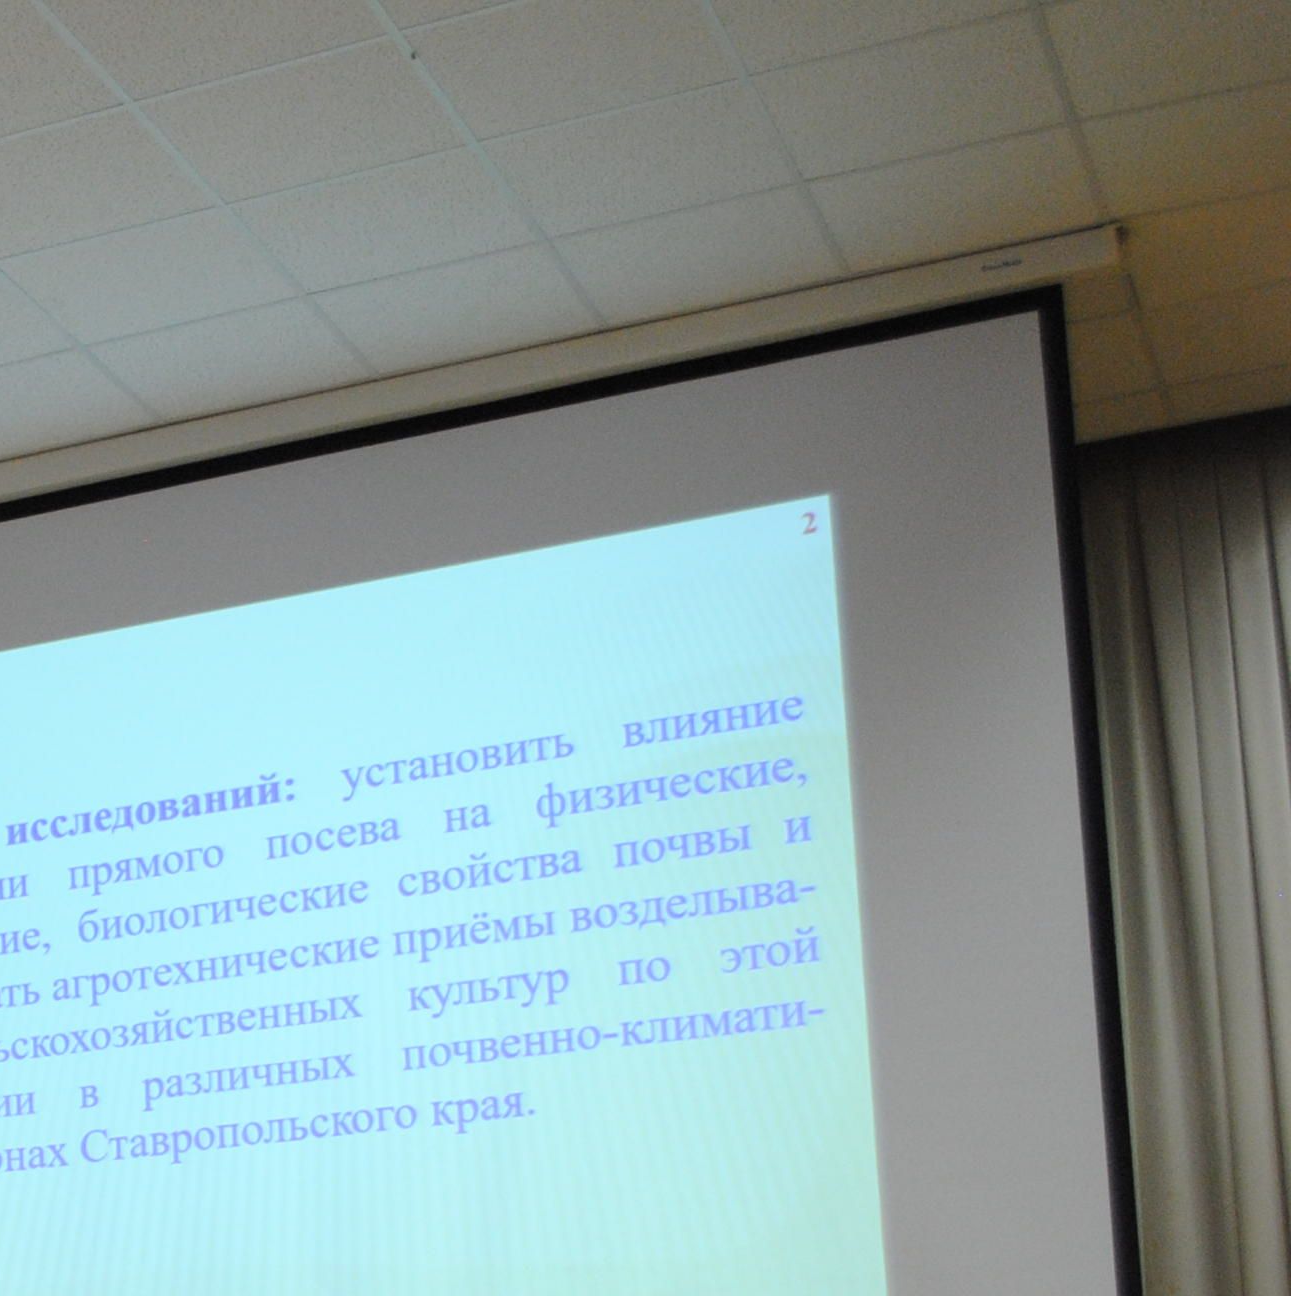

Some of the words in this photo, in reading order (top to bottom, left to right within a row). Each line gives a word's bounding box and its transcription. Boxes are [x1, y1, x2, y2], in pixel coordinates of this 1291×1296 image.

[801, 511, 817, 535] 2
[6, 772, 295, 845] исследований:
[341, 734, 575, 802] установить
[623, 697, 803, 747] влияние
[69, 845, 224, 896] прямого
[267, 818, 401, 859] посева
[444, 804, 492, 833] на
[536, 758, 807, 828] физические,
[78, 881, 368, 943] биологические
[398, 850, 583, 897] свойства
[615, 825, 751, 867] почвы
[785, 816, 811, 843] и
[53, 936, 379, 1006] агротехнические
[394, 912, 554, 963] приёмы
[571, 880, 815, 932] возделыва-
[409, 969, 569, 1018] культур
[619, 957, 671, 985] по
[721, 926, 819, 972] этой
[81, 1085, 99, 1108] в
[143, 1054, 355, 1111] различных
[404, 1001, 824, 1070] почвенно-климати-
[80, 1105, 417, 1164] Ставропольского
[432, 1093, 535, 1134] края.
